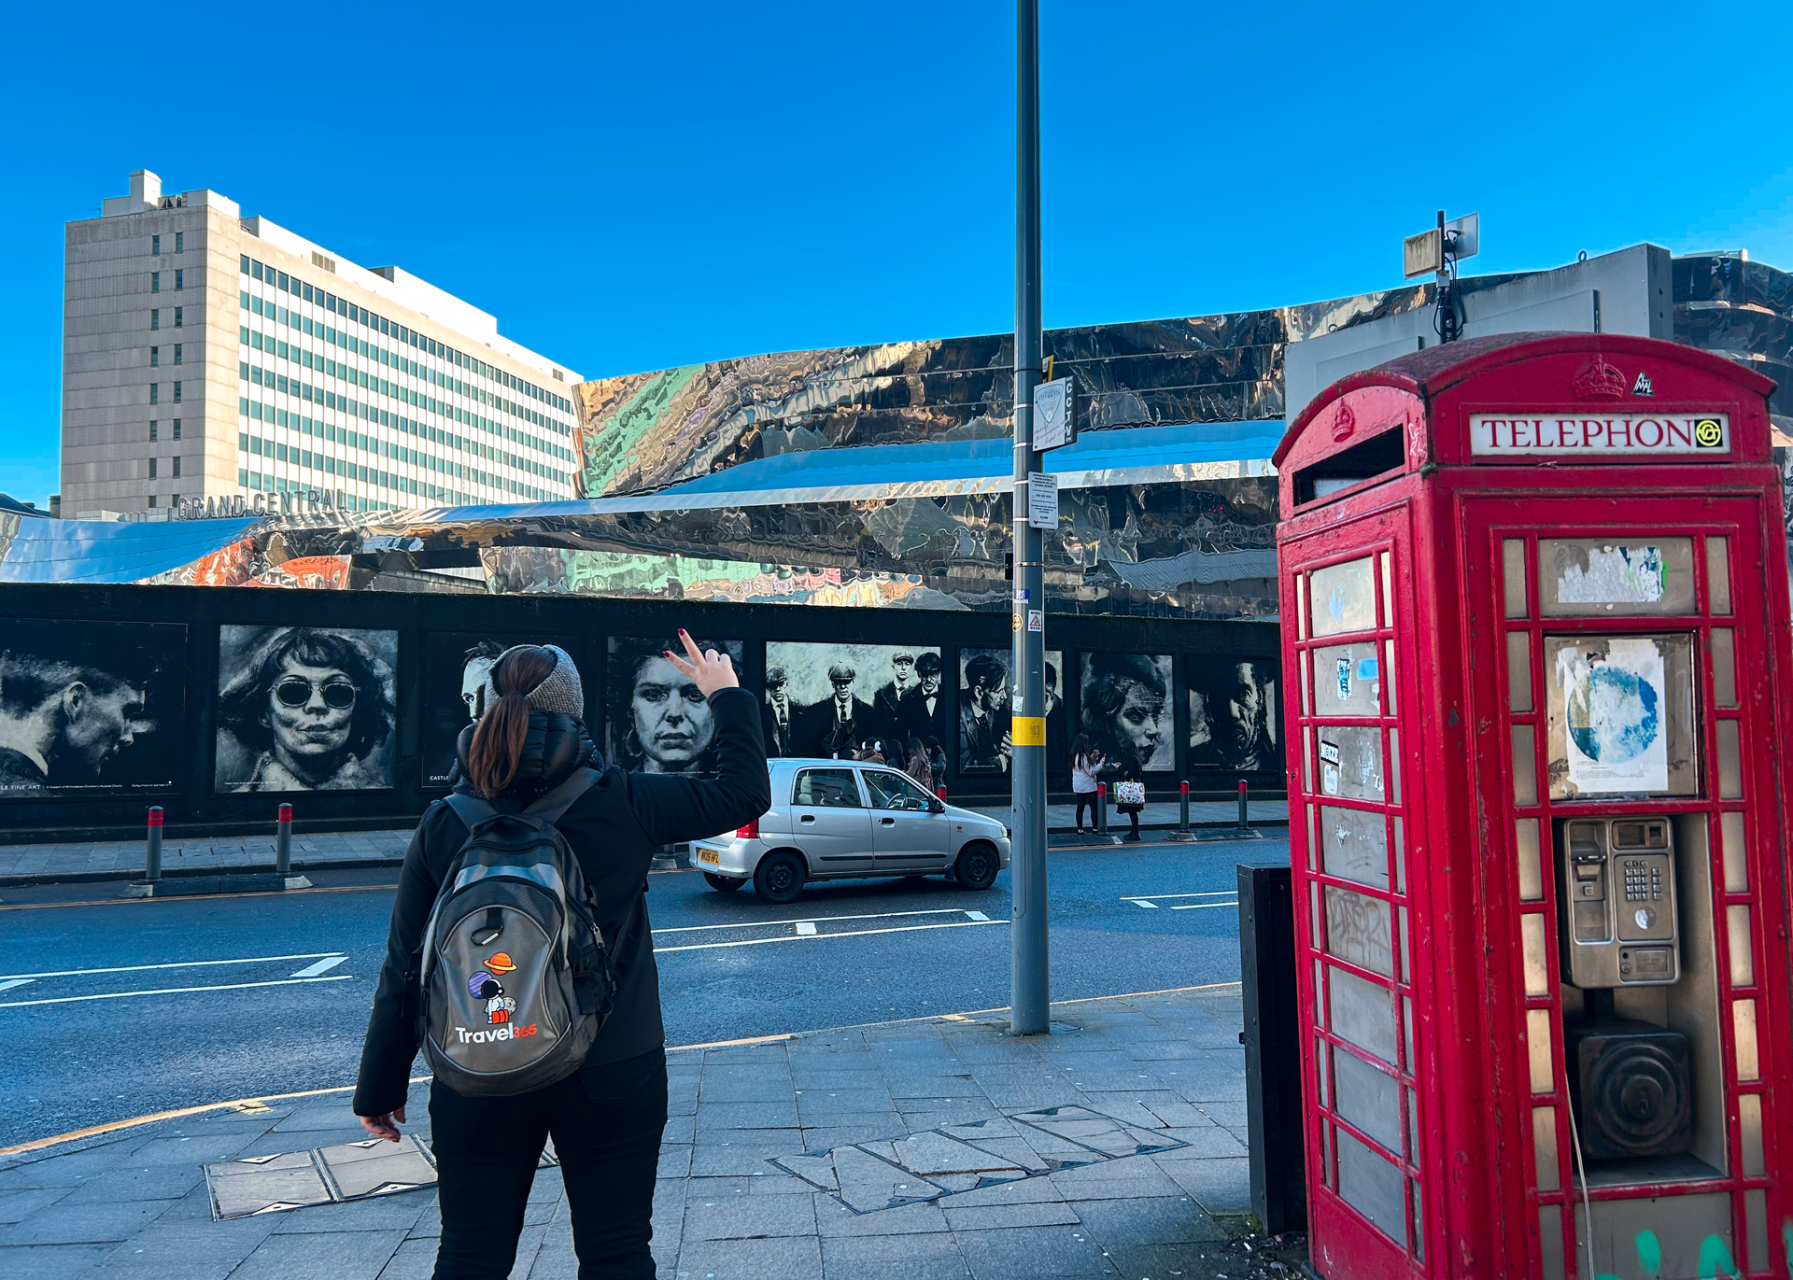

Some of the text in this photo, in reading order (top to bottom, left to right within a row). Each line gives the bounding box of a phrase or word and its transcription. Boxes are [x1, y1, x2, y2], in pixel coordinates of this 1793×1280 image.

[1481, 419, 1693, 448] TELEPHON
[177, 488, 347, 519] GRAND CENTRAL
[455, 1022, 537, 1044] Travel365
